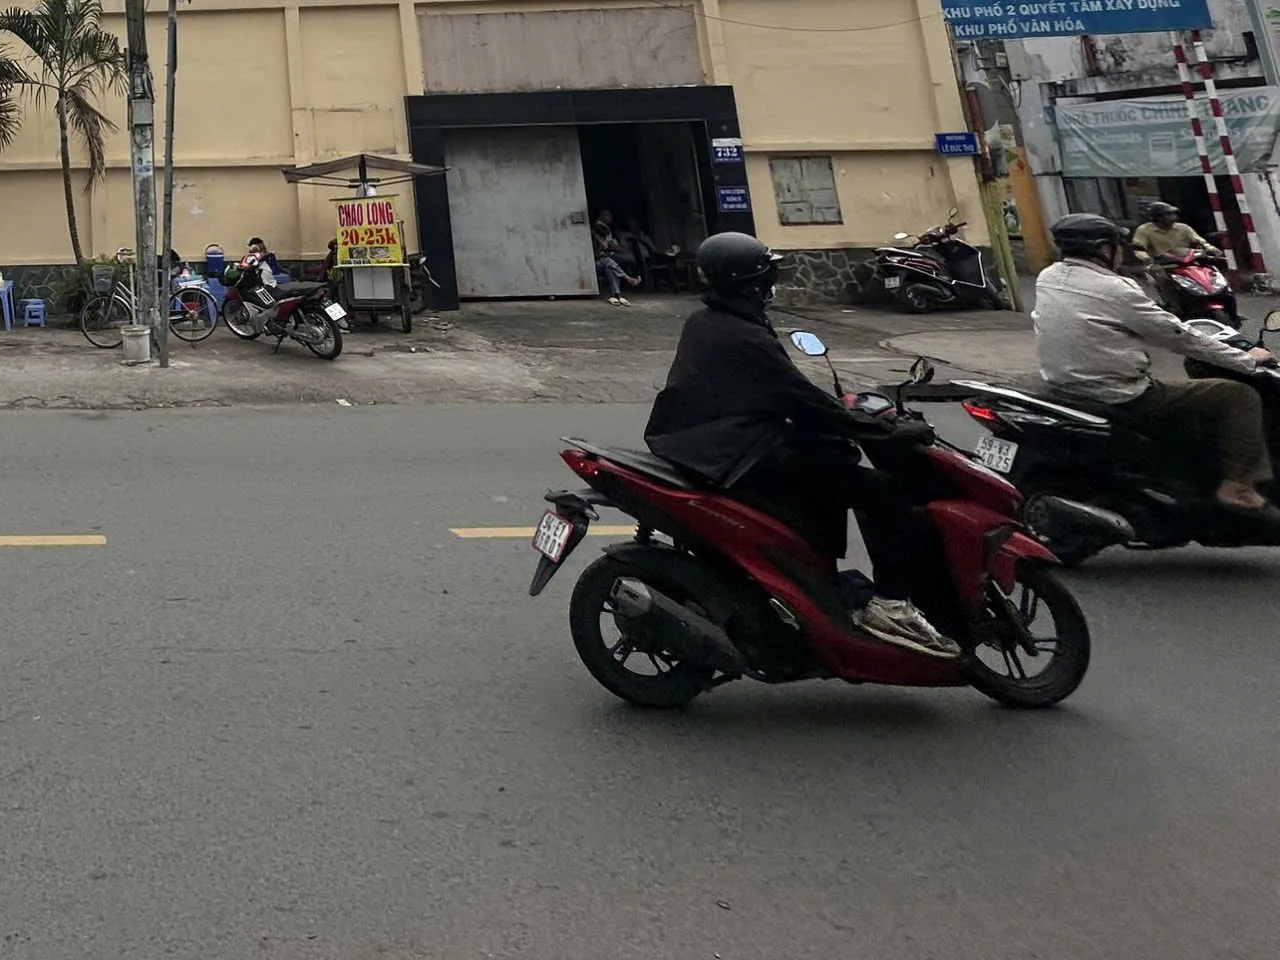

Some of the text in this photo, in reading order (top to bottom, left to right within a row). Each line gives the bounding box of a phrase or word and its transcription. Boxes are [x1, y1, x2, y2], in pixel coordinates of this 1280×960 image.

[943, 7, 971, 19] KHU
[975, 1, 1003, 17] PHỐ
[1006, 5, 1016, 16] 2
[955, 24, 985, 36] KHU
[988, 18, 1017, 35] PHỐ
[715, 147, 739, 158] 732
